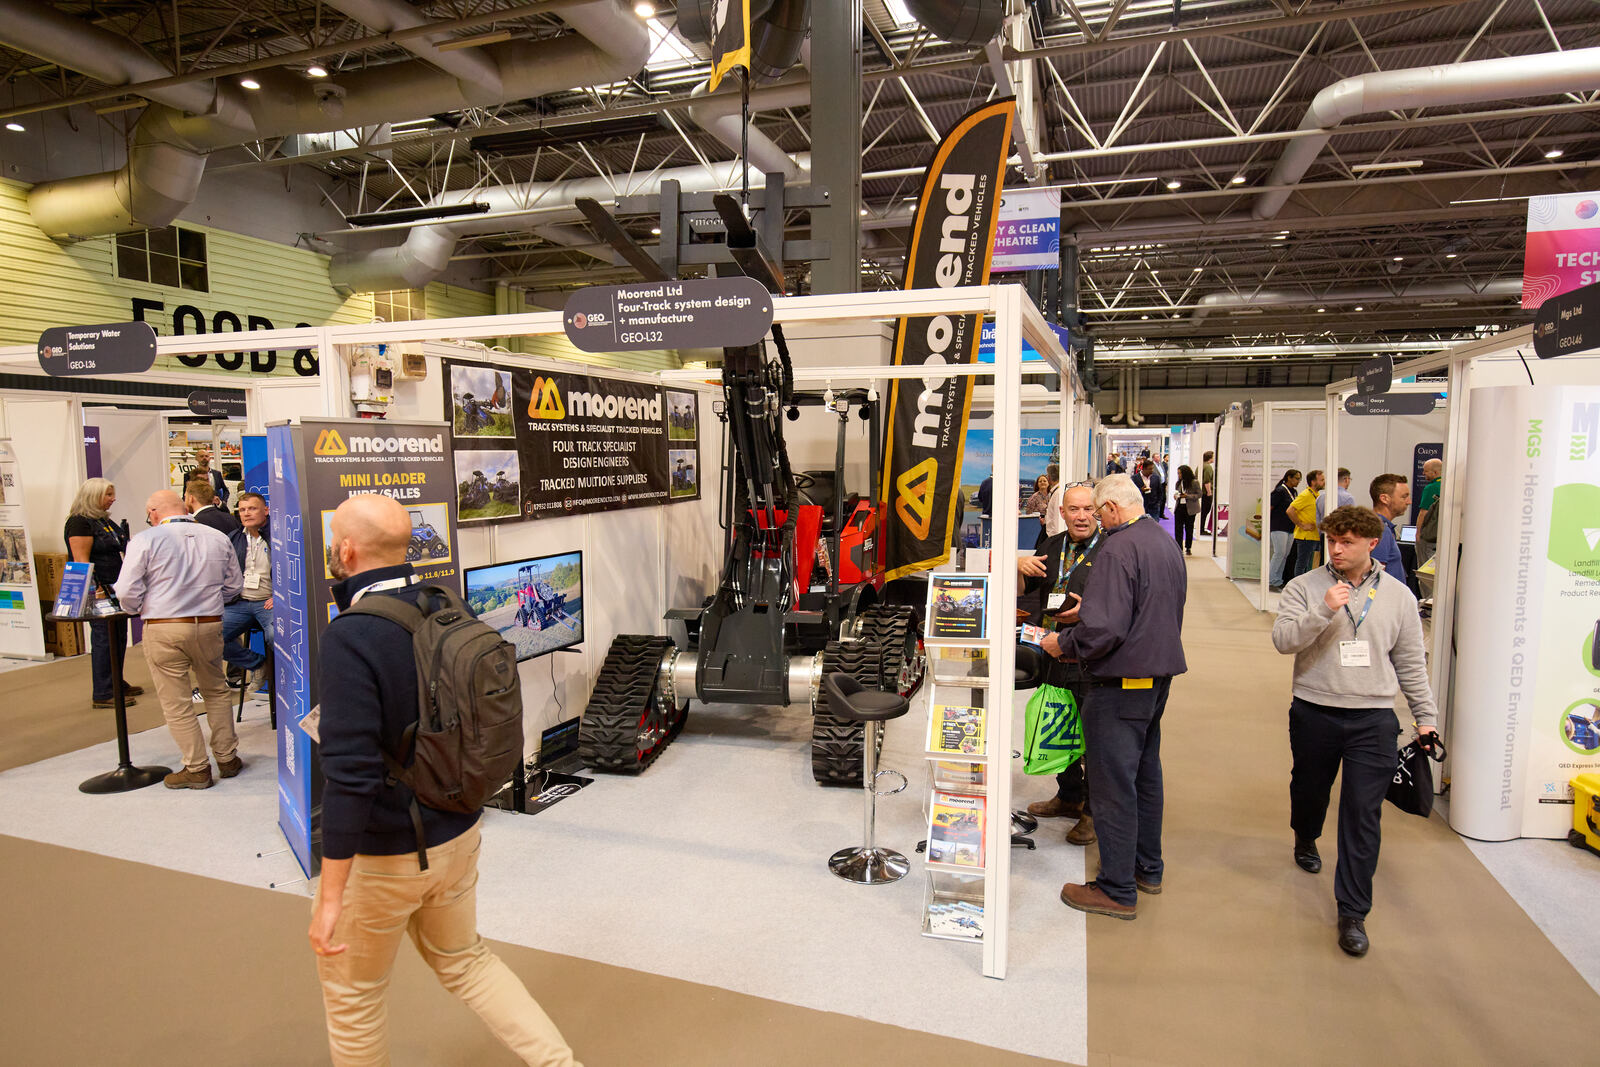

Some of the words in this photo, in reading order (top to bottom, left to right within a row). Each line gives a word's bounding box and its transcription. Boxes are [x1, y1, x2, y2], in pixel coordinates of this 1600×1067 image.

[1008, 225, 1016, 235] &
[1019, 223, 1056, 234] CLEAN
[617, 288, 664, 300] Moorend
[667, 285, 683, 296] Ltd
[618, 300, 671, 313] Four-Track
[674, 298, 711, 311] system
[714, 296, 751, 310] design
[912, 173, 975, 448] mooend
[941, 413, 953, 448] TRACK
[965, 232, 979, 285] TRACKED
[974, 174, 987, 230] VEHICLES
[1560, 309, 1572, 321] Mgs
[1573, 304, 1583, 316] Ltd
[587, 313, 605, 322] GEO
[619, 317, 626, 325] +
[628, 314, 694, 326] manufacture
[68, 331, 100, 341] Temporary
[101, 330, 121, 338] Water
[620, 331, 663, 344] GEO-L32
[1559, 333, 1583, 349] GEO-L46
[69, 343, 95, 351] Solutions
[70, 360, 96, 370] GEO-L36
[568, 391, 662, 421] moorend
[528, 422, 551, 432] TRACK
[551, 423, 579, 432] SYSTEMS
[586, 425, 615, 433] SPECIALIST
[616, 426, 639, 434] TRACKED
[350, 434, 444, 453] moorend
[553, 441, 574, 453] FOUR
[577, 440, 601, 452] TRACK
[603, 441, 637, 452] SPECIALIST
[1526, 419, 1543, 458] MGS
[563, 457, 592, 469] DESIGN
[593, 456, 629, 468] ENGINEERS
[340, 473, 371, 488] MINI
[374, 472, 426, 487] LOADER
[540, 478, 575, 491] TRACKED
[578, 476, 616, 489] MULTIONE
[616, 474, 648, 486] SUPPLIERS
[1521, 474, 1538, 527] Heron
[1513, 530, 1534, 632] Instruments
[1568, 569, 1595, 577] Landfill
[1513, 637, 1526, 648] &
[1510, 654, 1524, 688] QED
[1500, 692, 1521, 811] Environmental
